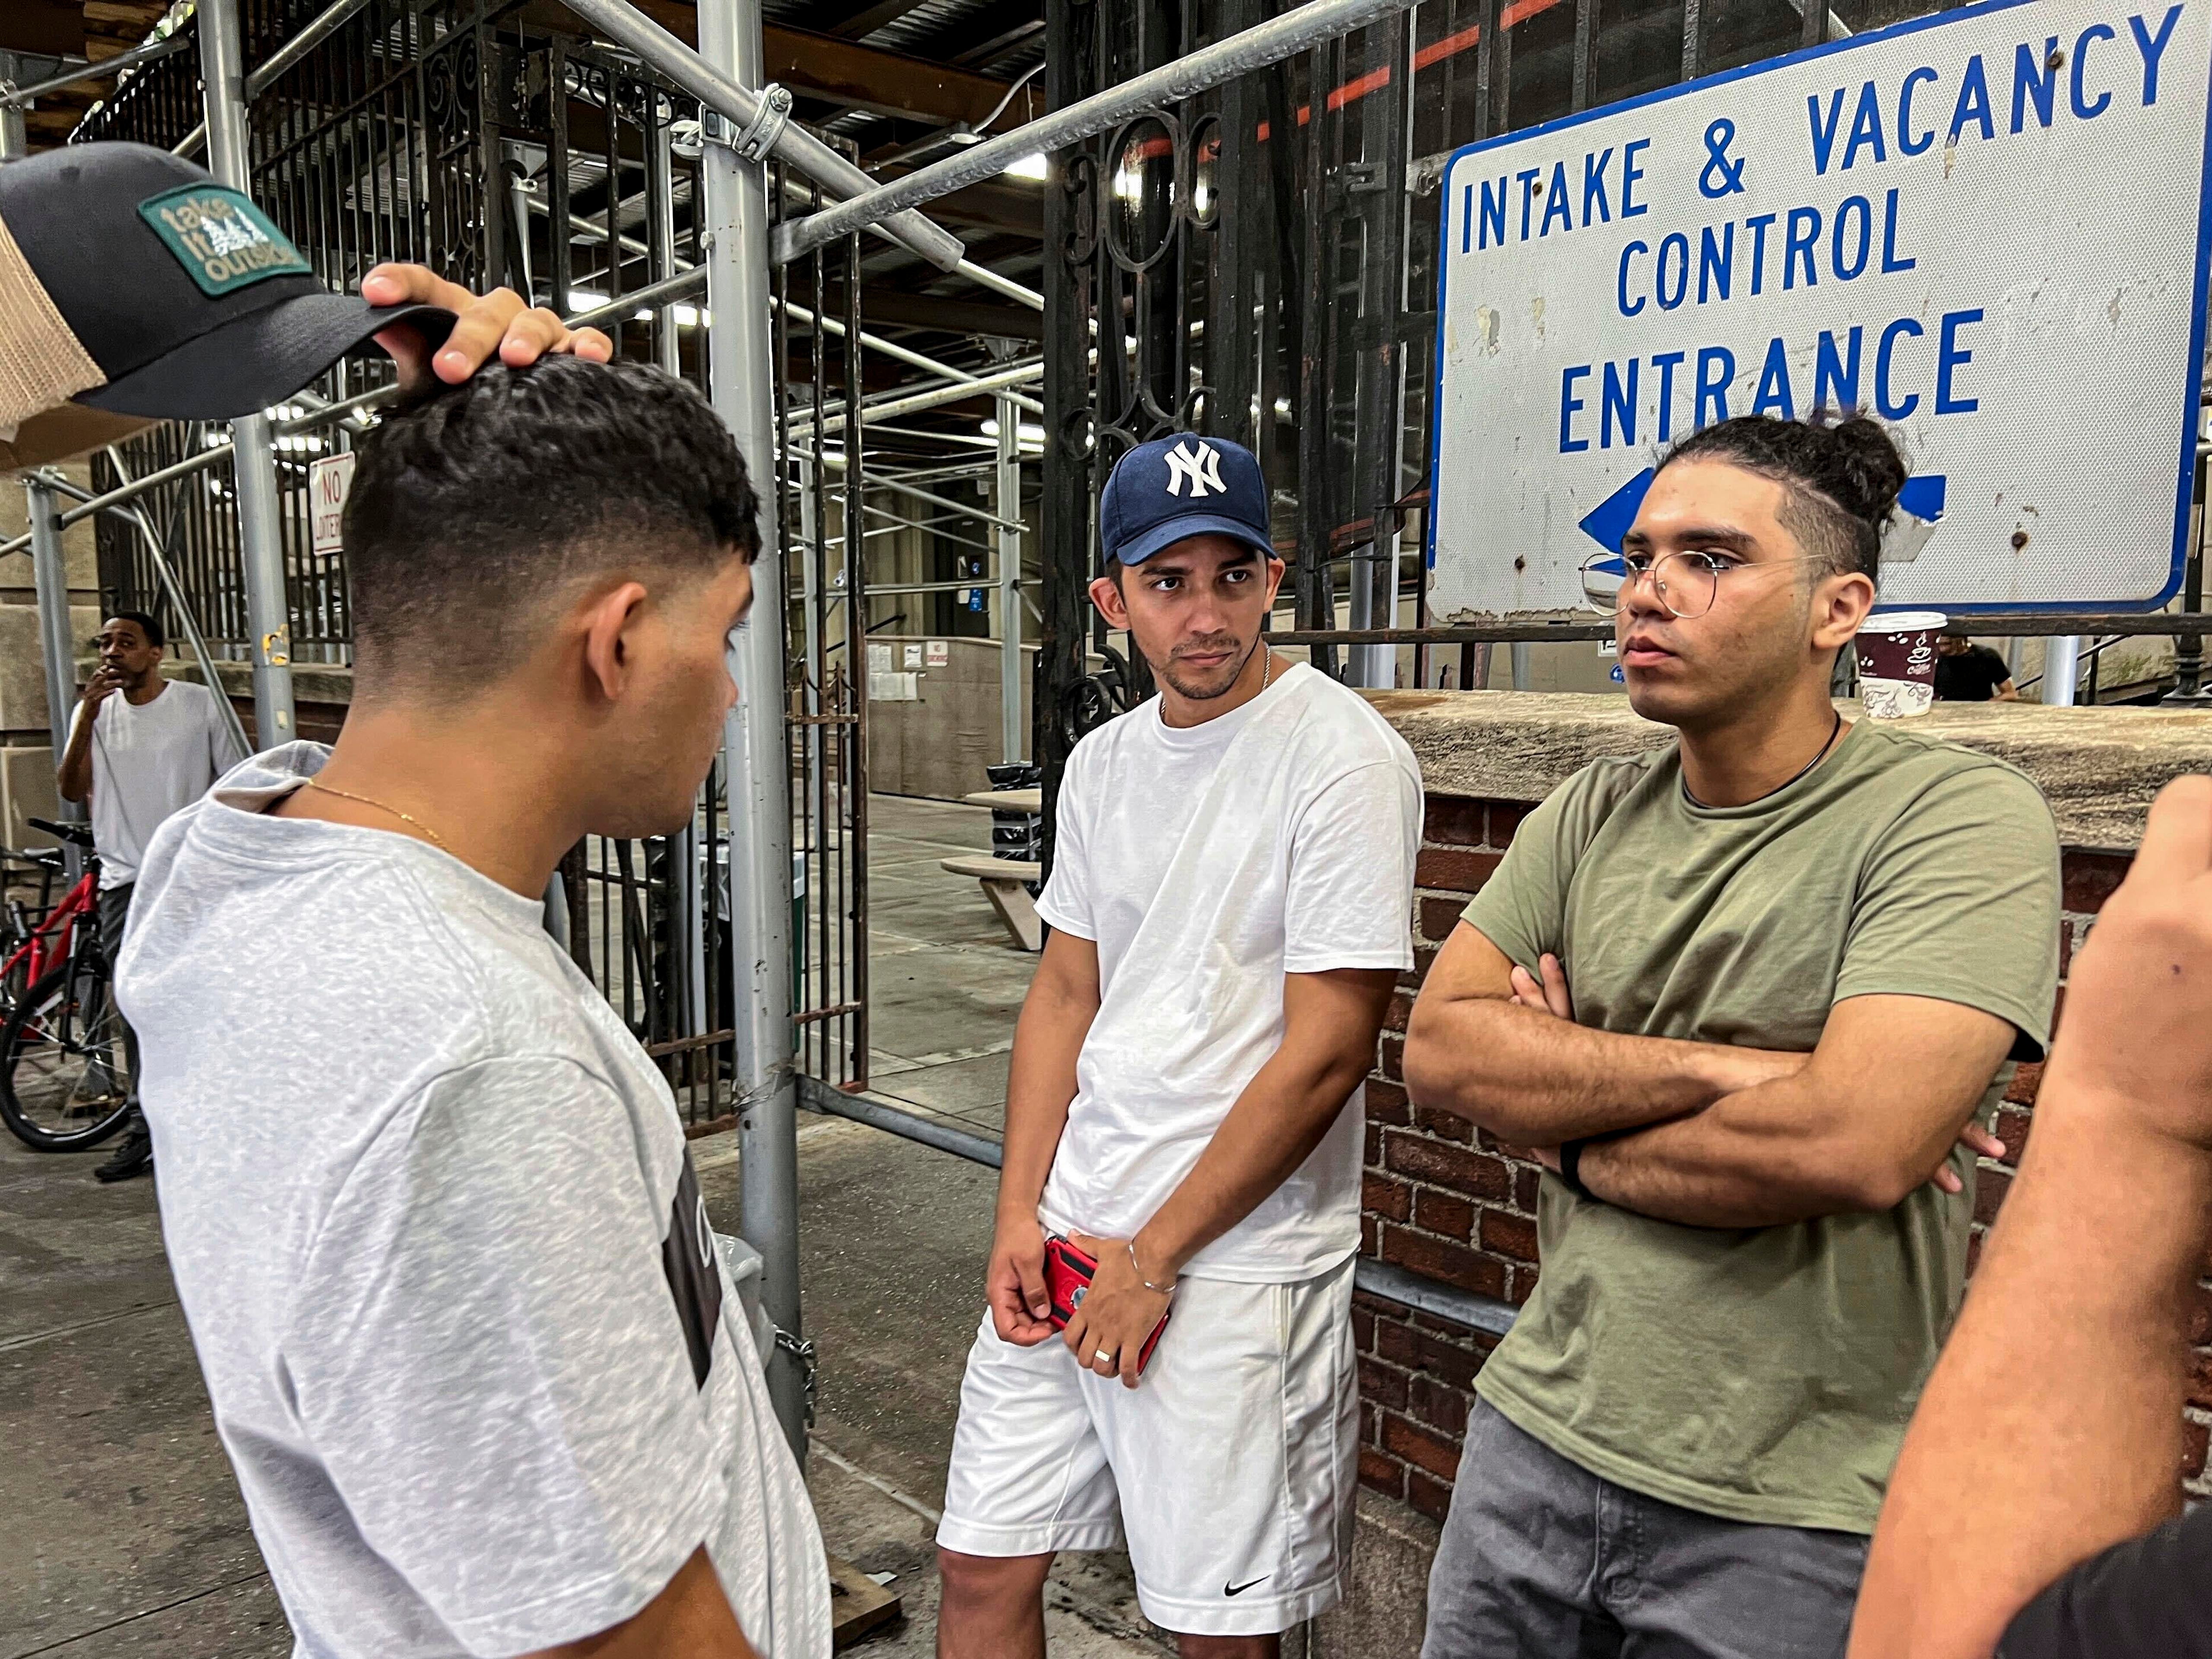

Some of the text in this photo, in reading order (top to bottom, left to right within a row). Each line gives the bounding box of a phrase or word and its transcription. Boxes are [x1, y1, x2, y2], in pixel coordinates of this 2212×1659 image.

[1462, 4, 2183, 254] INTAKE & VACANCY
[1618, 189, 1916, 317] CONTROL
[1560, 308, 1984, 453] ENTRANCE
[323, 470, 341, 505] NO
[1164, 440, 1227, 497] NY
